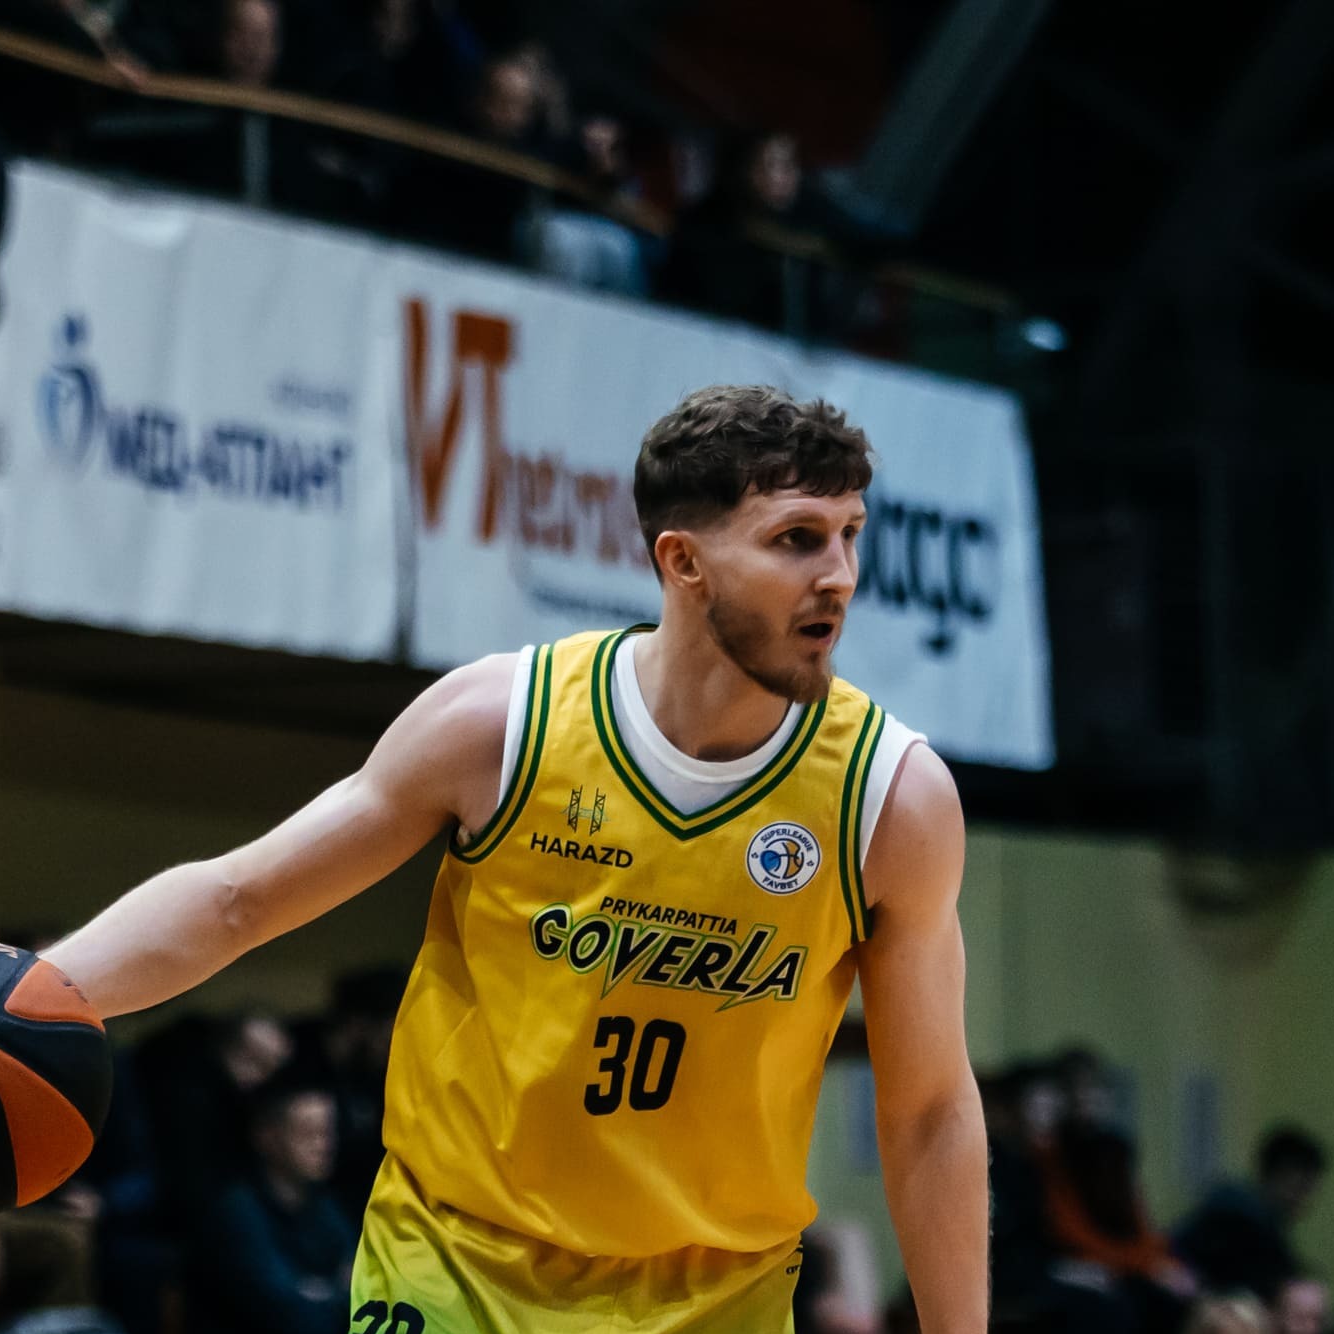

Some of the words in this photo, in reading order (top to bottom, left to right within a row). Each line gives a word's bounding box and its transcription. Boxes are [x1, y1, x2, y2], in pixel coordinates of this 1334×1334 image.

[530, 832, 633, 868] HARAZD
[760, 828, 814, 852] SUPERLEAGUE
[762, 876, 798, 890] FAVBET
[598, 896, 738, 936] PRYKARPATTIA
[530, 903, 809, 1013] GOVERLA
[583, 1016, 687, 1117] 30
